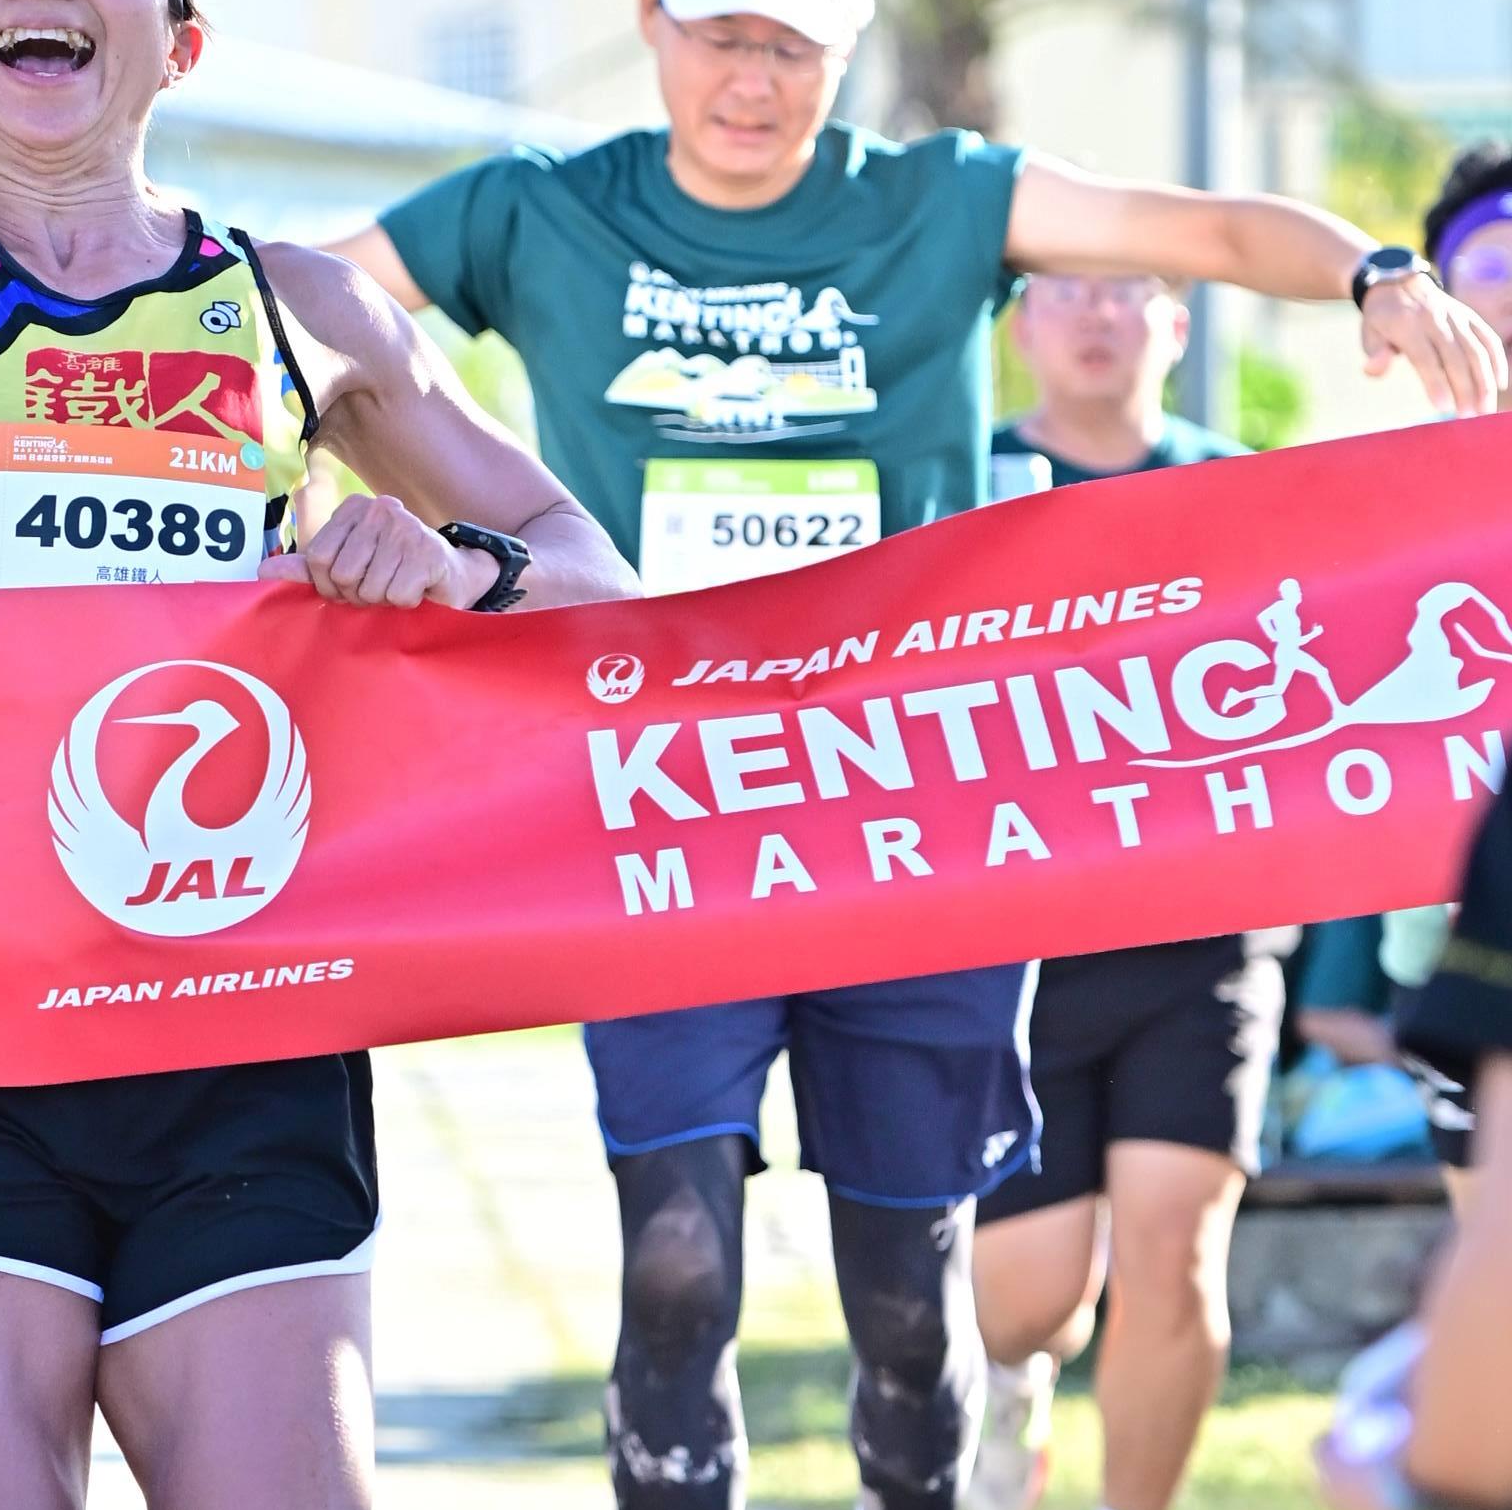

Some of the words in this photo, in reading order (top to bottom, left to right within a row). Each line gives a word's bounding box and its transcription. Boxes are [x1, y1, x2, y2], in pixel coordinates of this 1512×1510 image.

[59, 351, 123, 373] 高雄
[169, 446, 237, 476] 21KM
[14, 494, 247, 563] 40389
[712, 514, 862, 547] 50622
[96, 565, 166, 585] 高雄鐵人
[672, 631, 880, 686] JAPAN
[893, 578, 1203, 658] AIRLINES
[587, 640, 1287, 830] KENTING
[614, 730, 1506, 916] MARATHON
[124, 857, 266, 906] JAL
[38, 981, 162, 1010] JAPAN
[171, 959, 355, 999] AIRLINES
